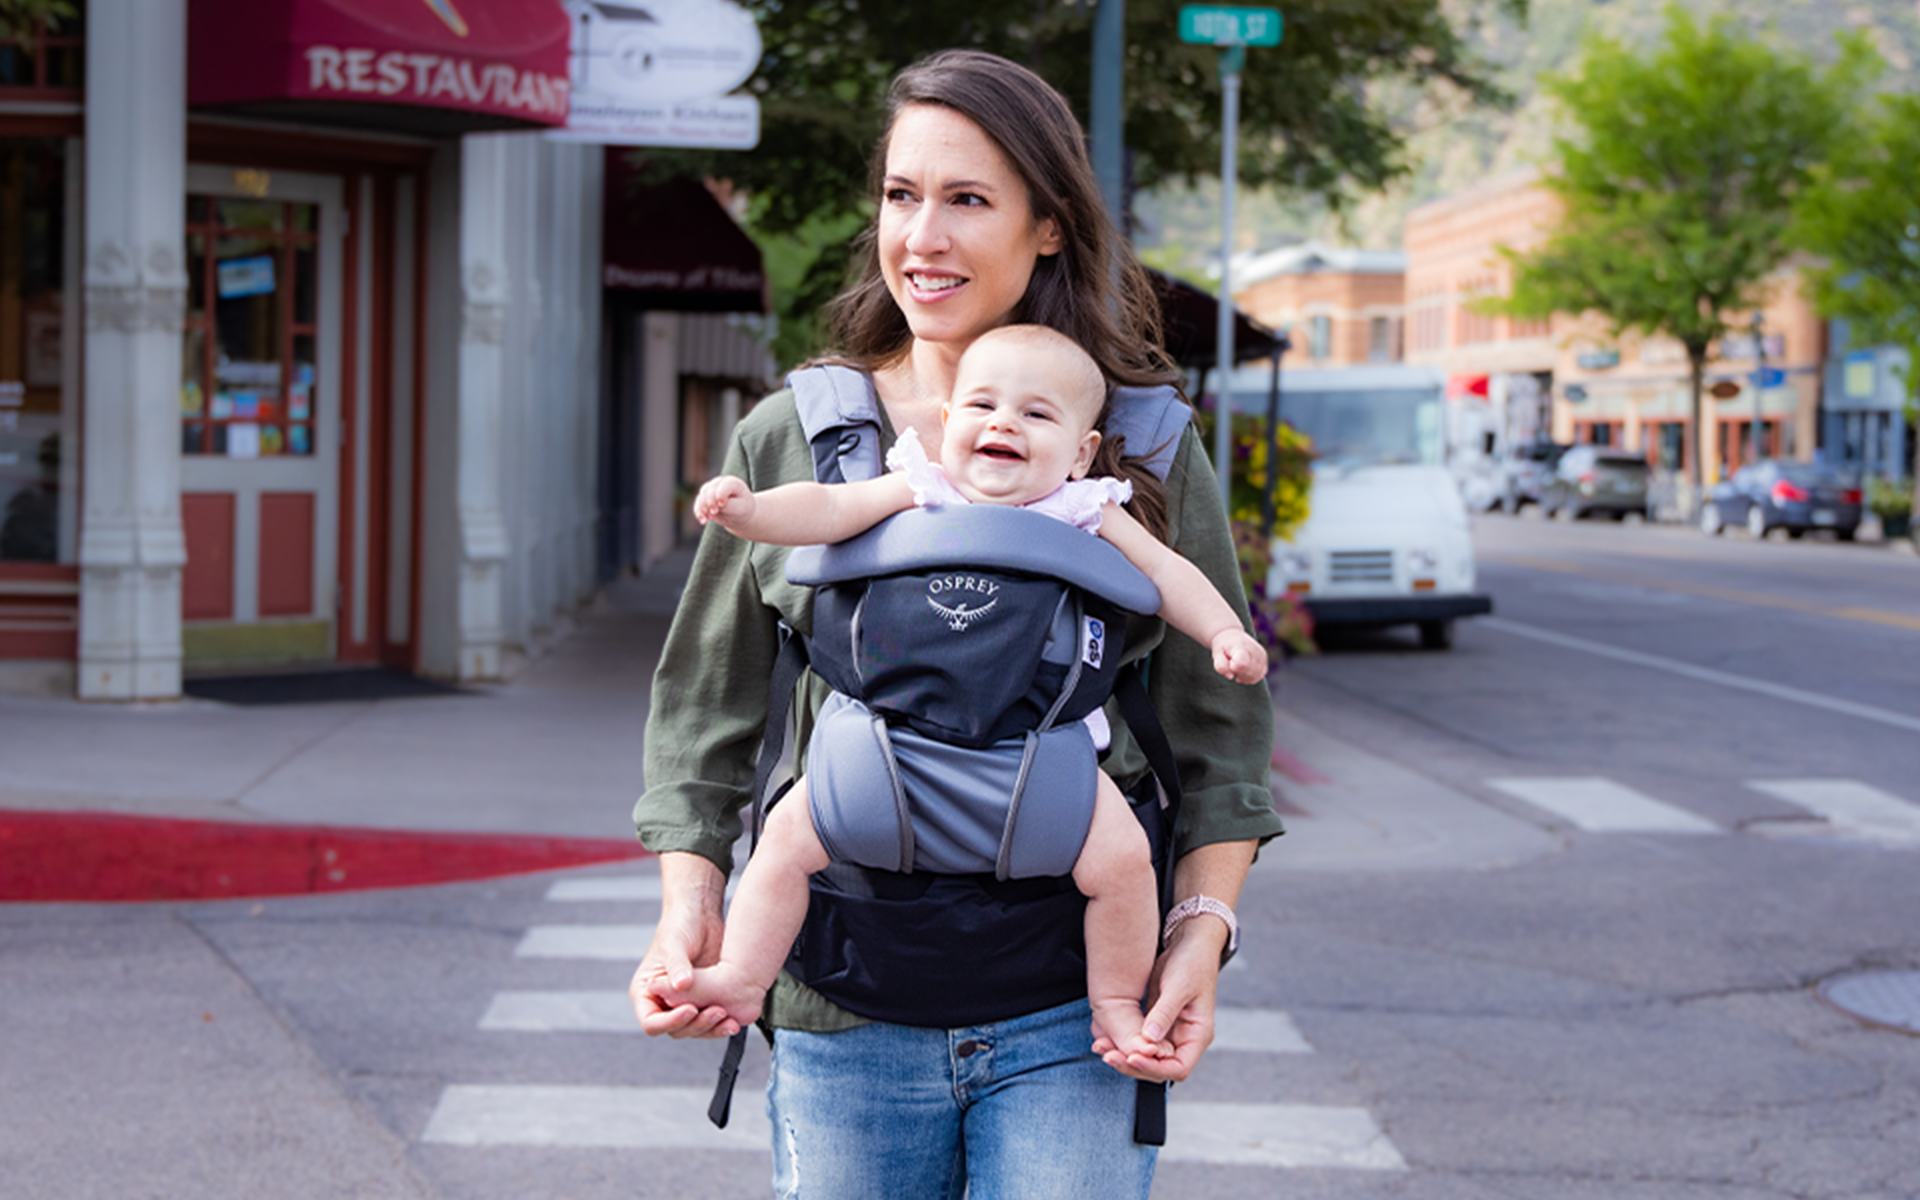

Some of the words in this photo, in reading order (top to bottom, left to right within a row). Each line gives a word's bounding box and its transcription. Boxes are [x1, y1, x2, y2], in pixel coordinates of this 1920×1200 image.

[1245, 12, 1267, 40] ST
[683, 266, 707, 288] of
[929, 575, 1000, 596] OSPREY
